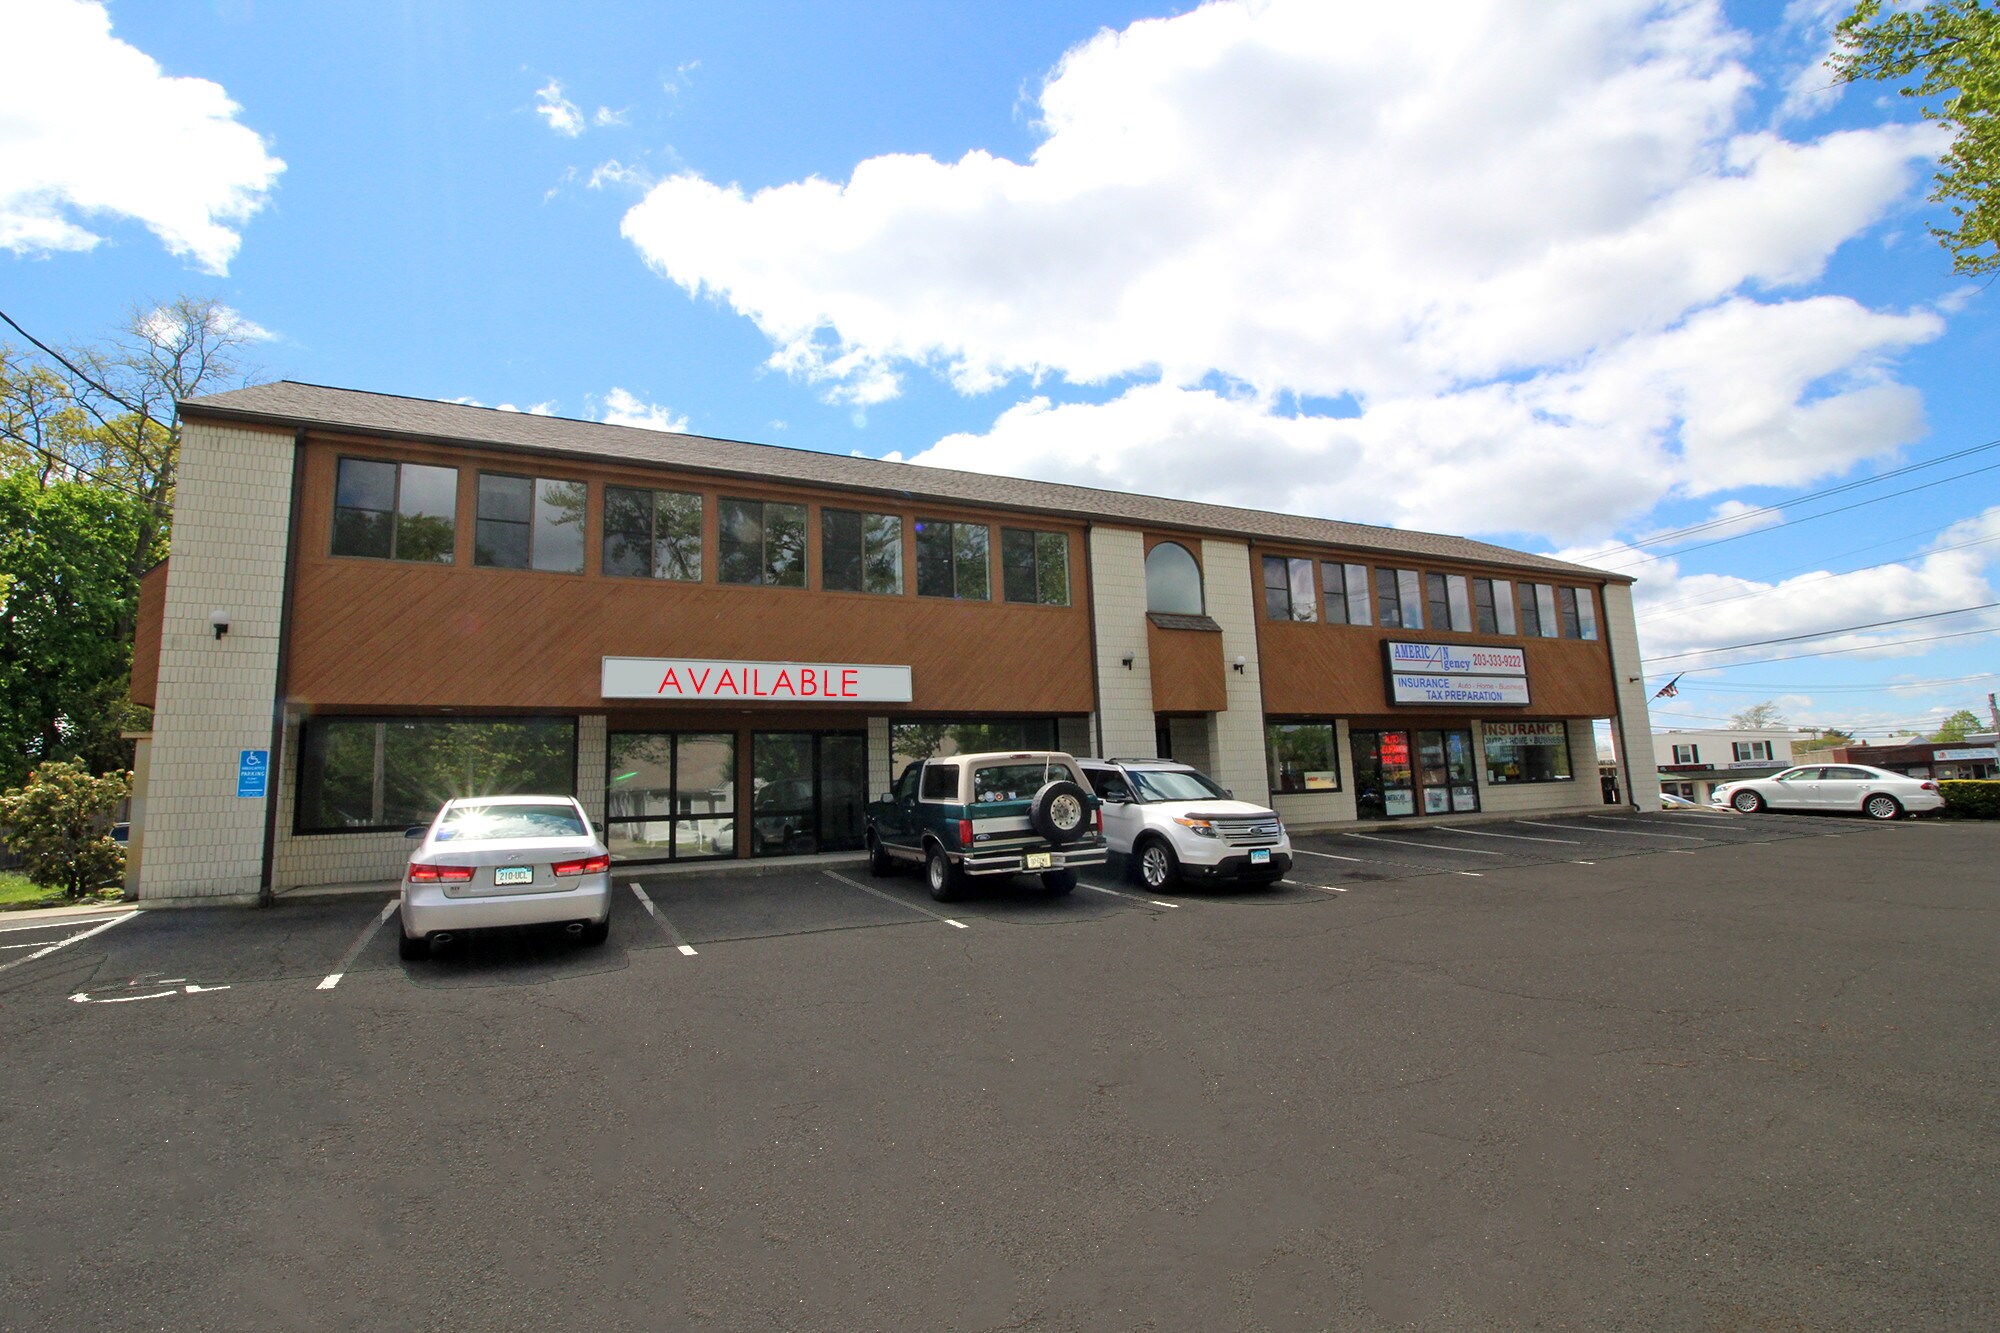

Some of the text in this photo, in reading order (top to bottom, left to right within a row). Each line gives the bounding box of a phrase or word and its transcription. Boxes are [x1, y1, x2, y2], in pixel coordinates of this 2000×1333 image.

[1473, 653, 1521, 668] 203-333-9222
[658, 667, 858, 697] AVAILABLE
[1398, 678, 1449, 688] INSURANCE
[1426, 690, 1503, 701] TAX PREPARATION
[1483, 723, 1563, 735] INSURANCE
